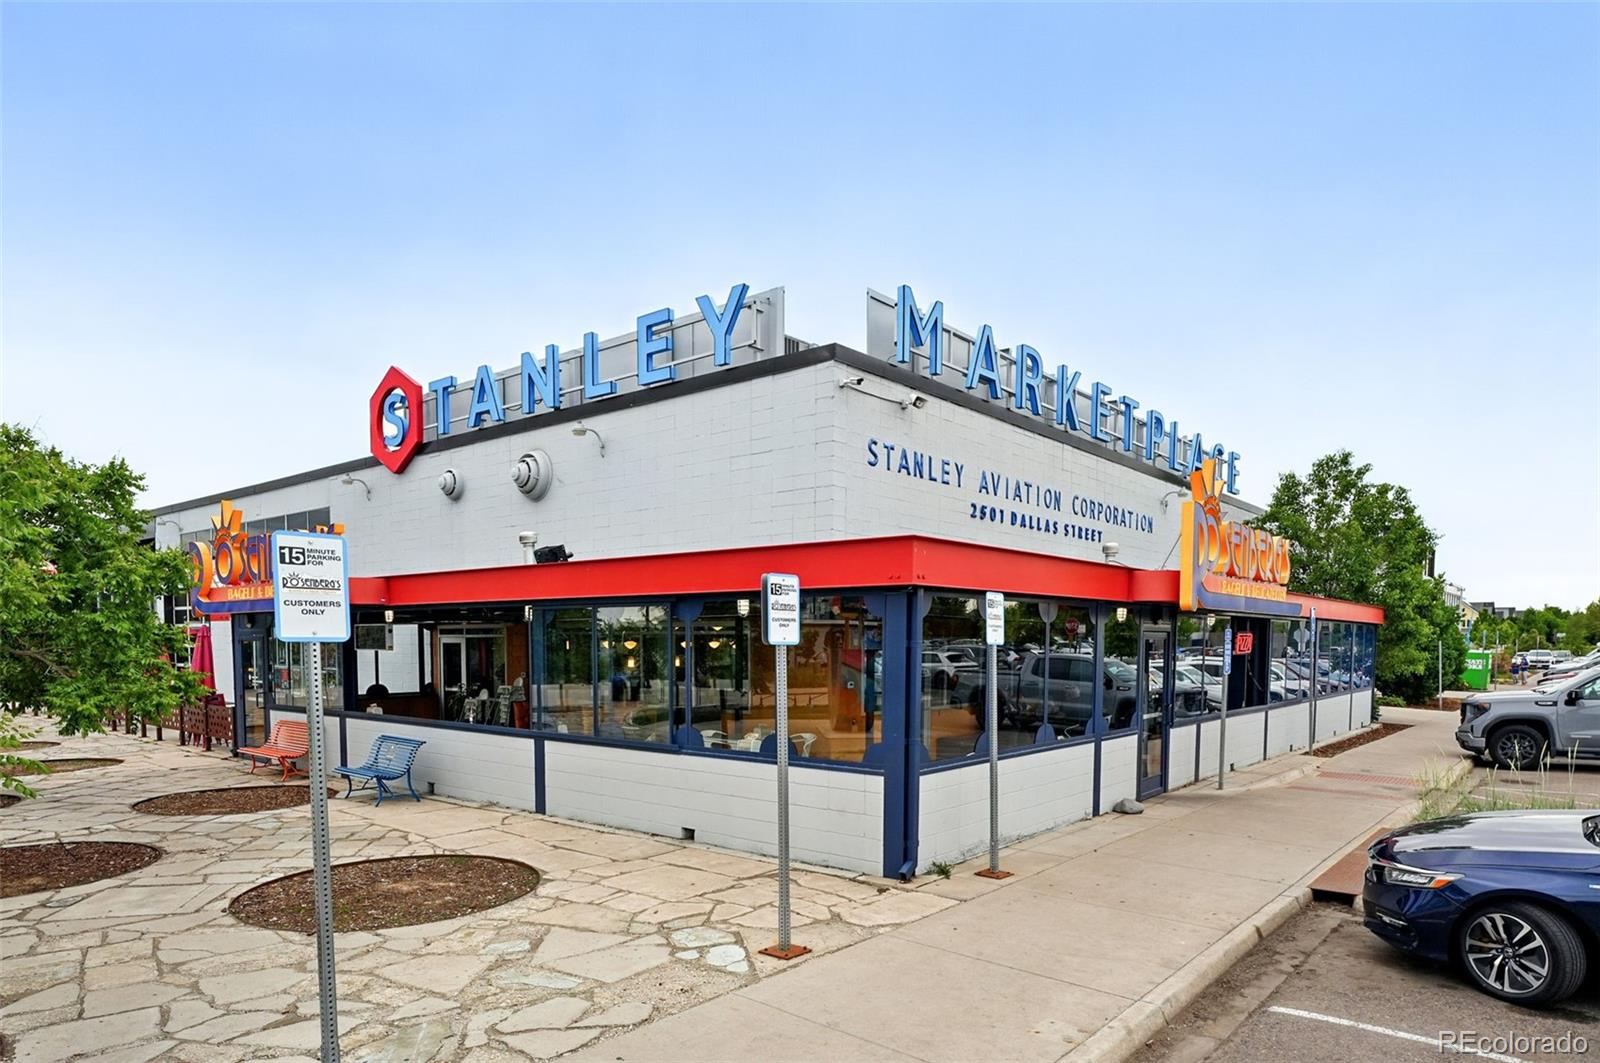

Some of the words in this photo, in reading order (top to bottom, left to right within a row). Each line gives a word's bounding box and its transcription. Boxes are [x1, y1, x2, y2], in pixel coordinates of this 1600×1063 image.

[383, 283, 750, 448] STANLEY
[867, 437, 964, 488] STANLEY
[978, 470, 1062, 512] AVIATION
[1072, 494, 1154, 534] CORPORATION
[970, 502, 1005, 524] 2501
[1010, 511, 1059, 535] DALLAS
[1064, 523, 1103, 543] STREET
[279, 547, 305, 565] 15
[771, 583, 782, 595] 15
[283, 599, 342, 608] CUSTOMERS
[301, 608, 326, 616] ONLY
